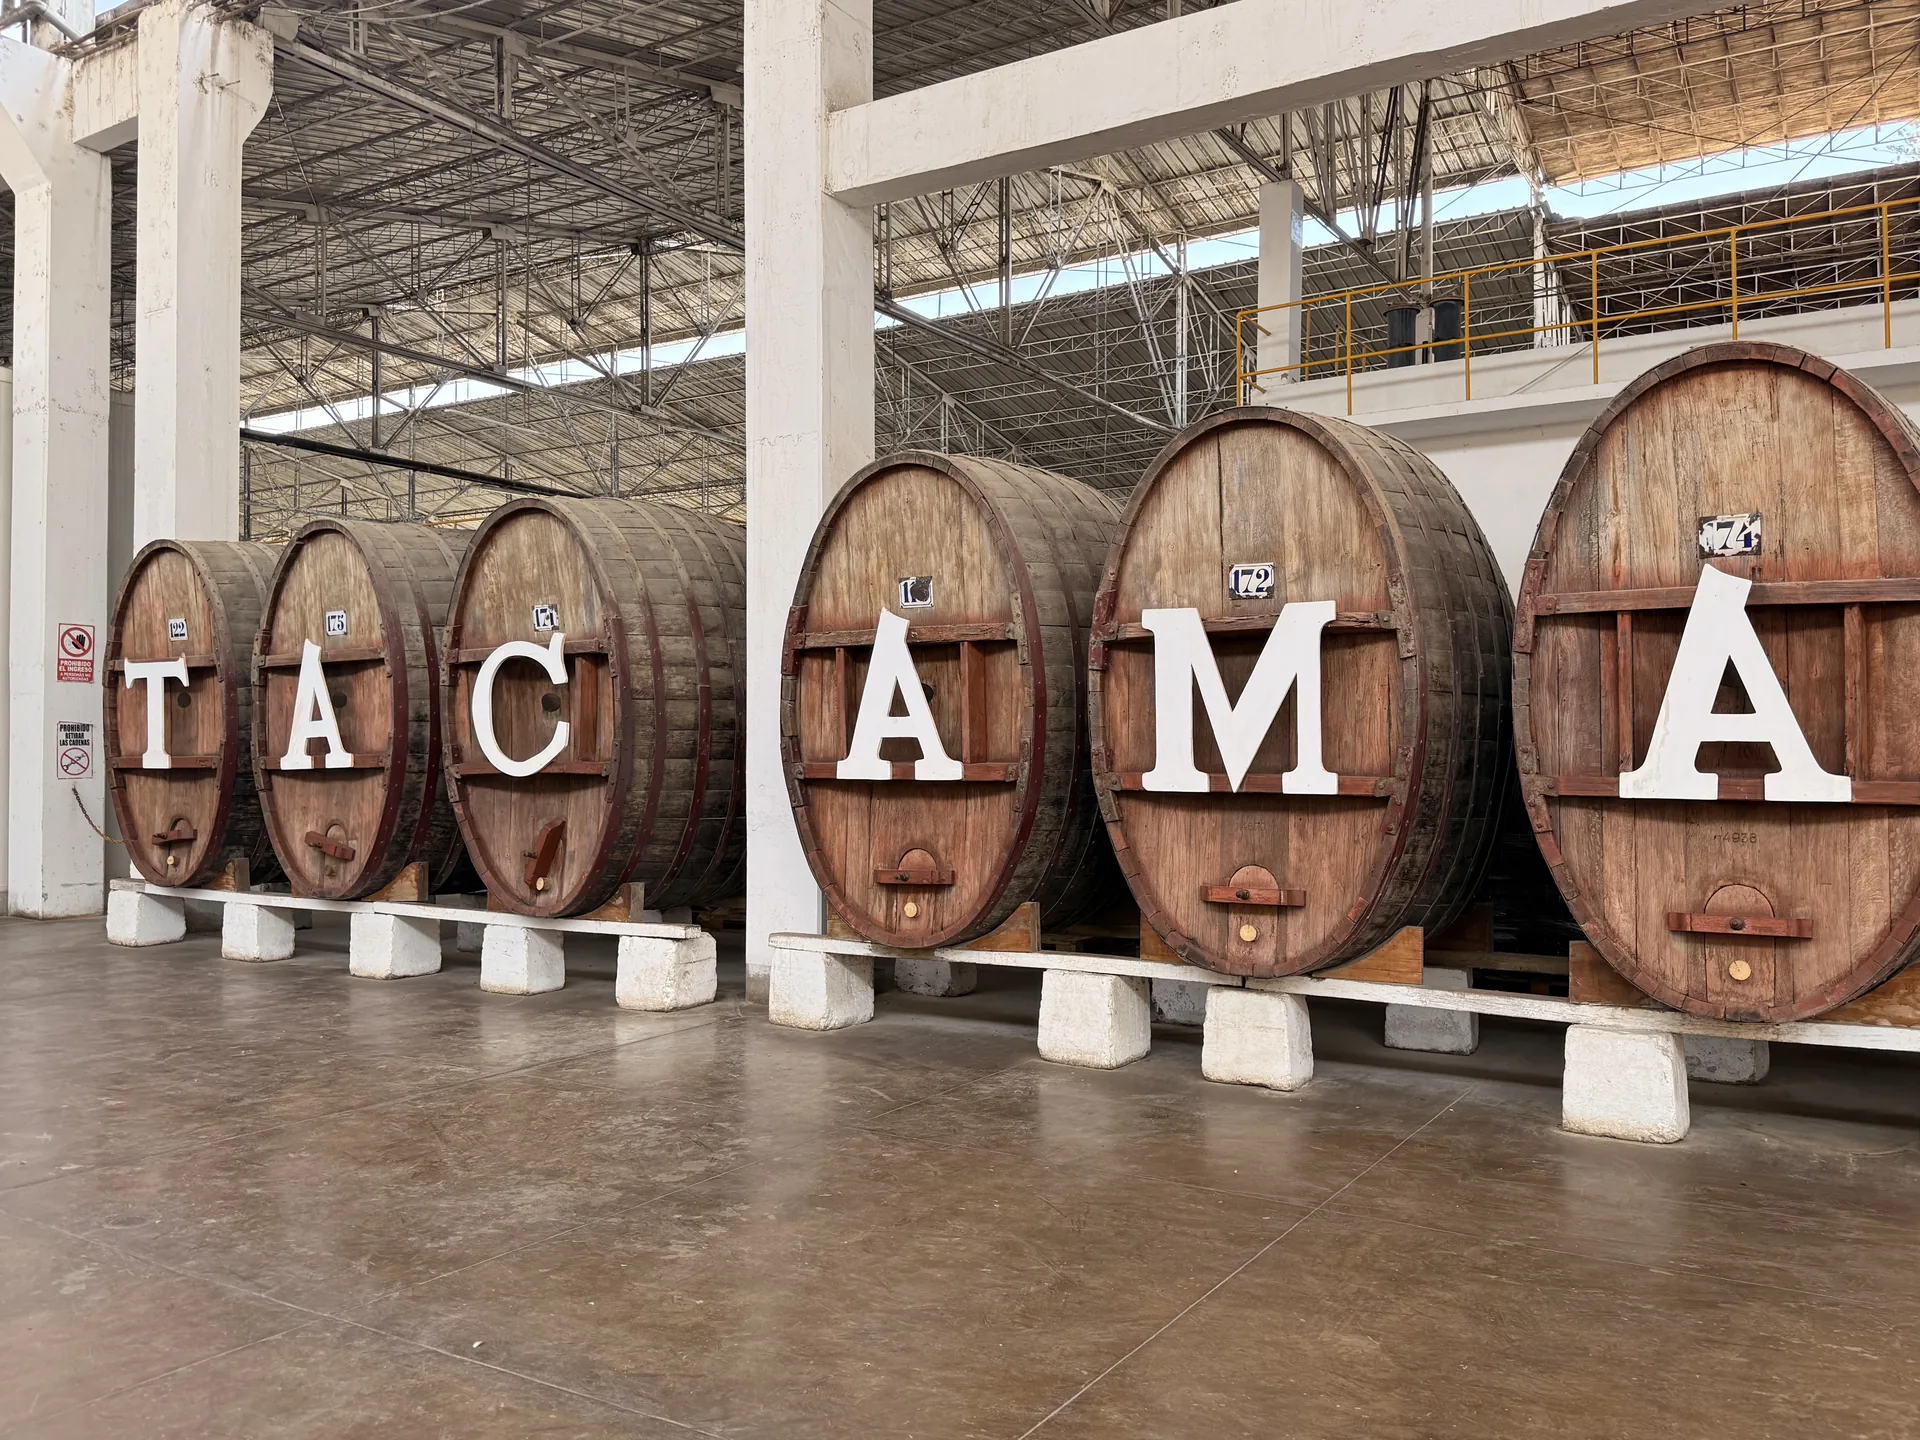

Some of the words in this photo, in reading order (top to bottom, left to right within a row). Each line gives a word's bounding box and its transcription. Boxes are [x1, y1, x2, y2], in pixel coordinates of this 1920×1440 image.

[1703, 520, 1755, 550] 74
[1231, 568, 1270, 593] 172
[169, 621, 186, 638] 122
[327, 614, 345, 632] 175
[125, 655, 190, 770] T
[280, 638, 354, 771] A
[471, 632, 570, 778] C
[837, 606, 963, 781] A
[1141, 600, 1338, 795] M
[1619, 563, 1852, 802] A
[59, 723, 90, 732] PROHIBIDO
